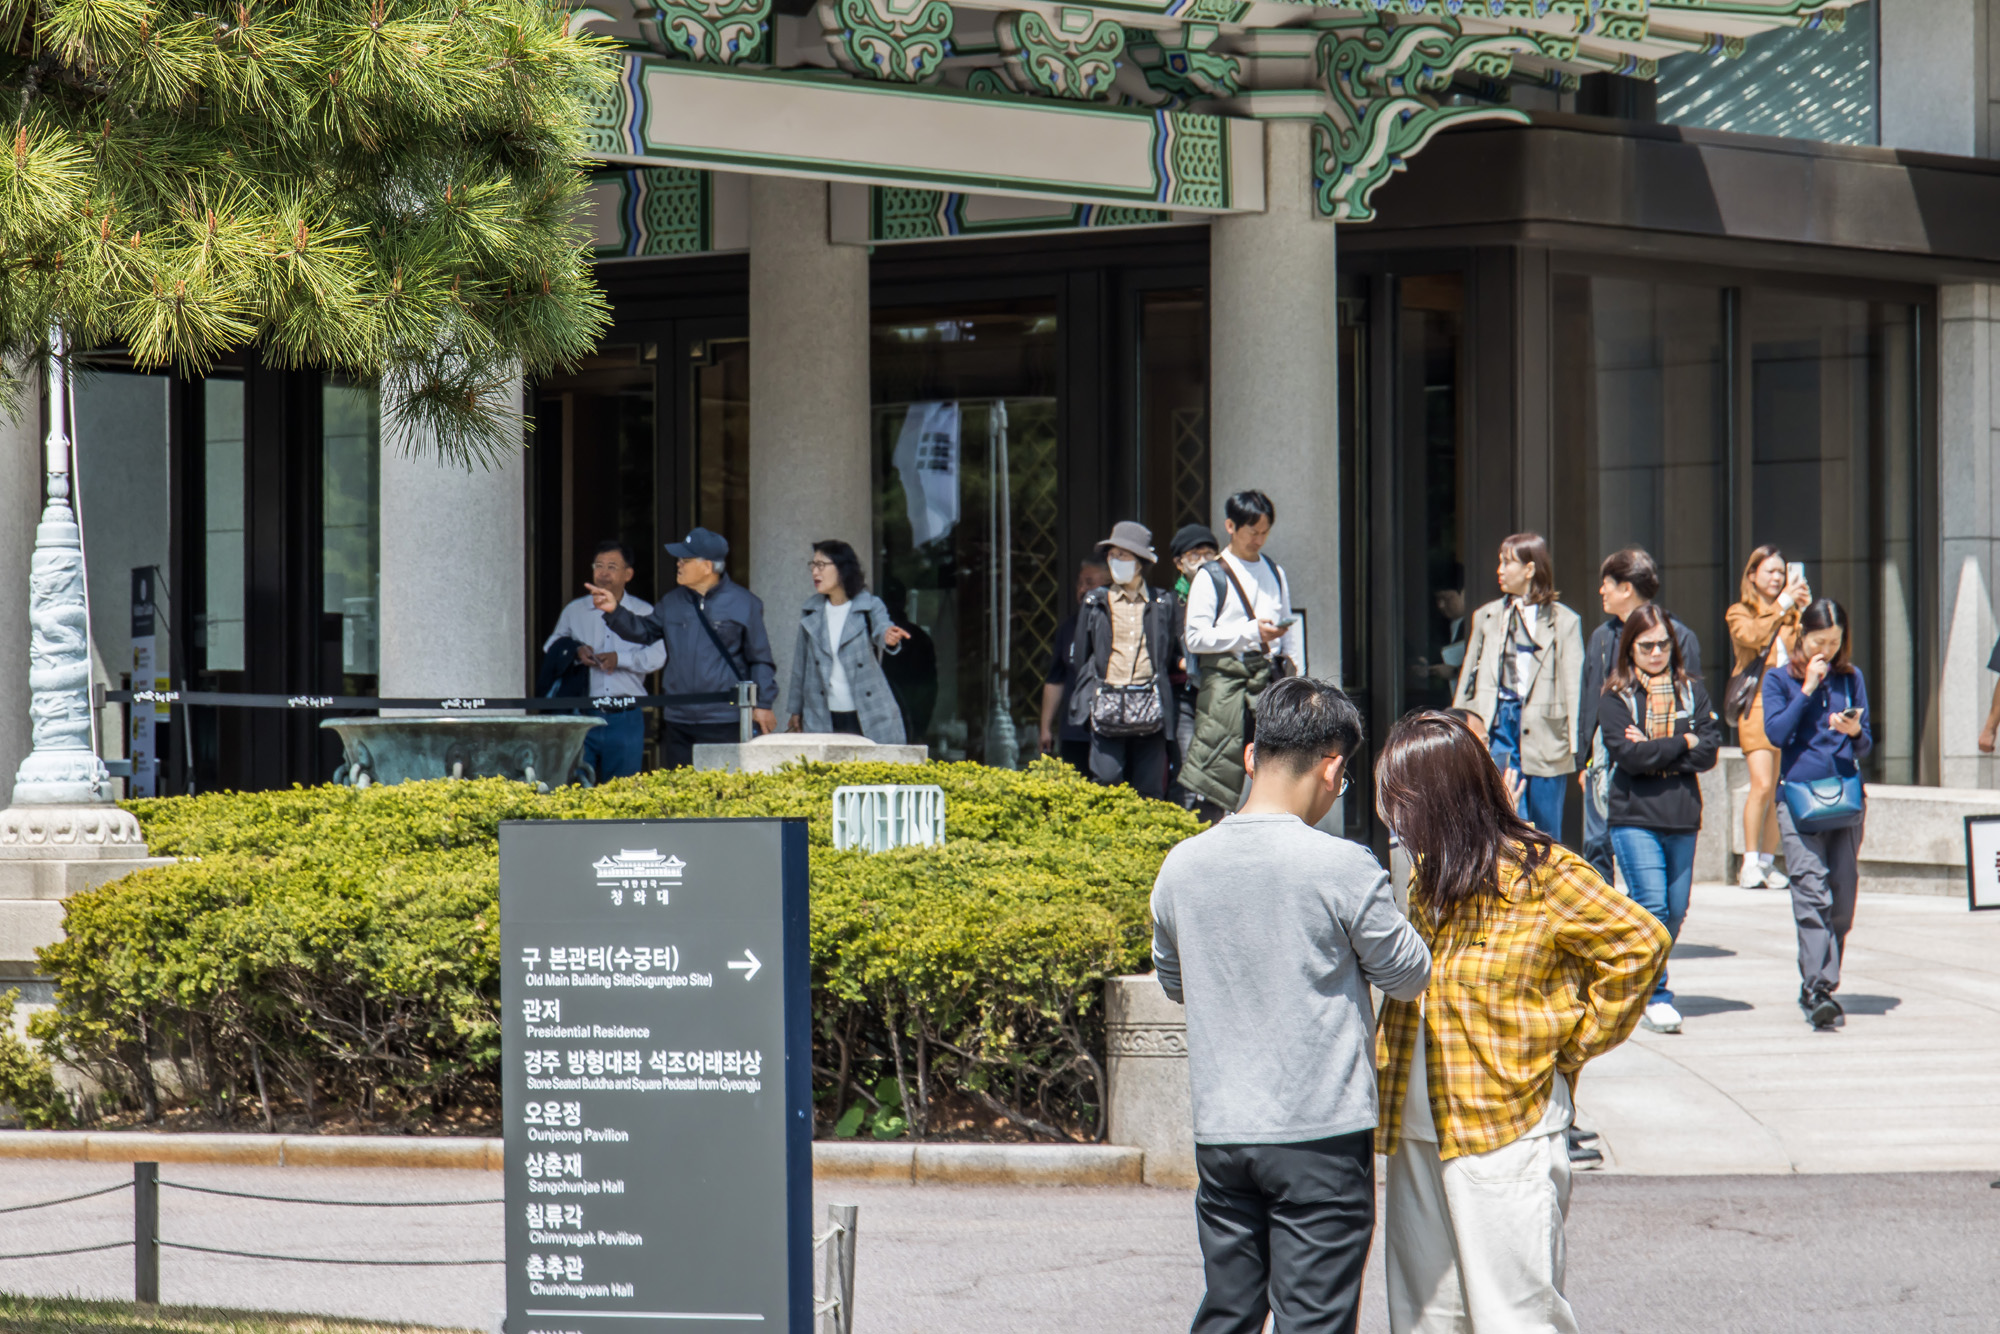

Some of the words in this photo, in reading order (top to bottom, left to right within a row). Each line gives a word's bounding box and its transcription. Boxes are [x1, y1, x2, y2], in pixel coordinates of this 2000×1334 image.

[521, 948, 541, 971] 구
[548, 945, 679, 972] 본관터(수궁터)
[525, 973, 543, 986] Old
[545, 973, 570, 986] Main
[571, 973, 611, 989] Building
[690, 973, 712, 988] Site)
[522, 998, 560, 1023] 관저
[526, 1025, 590, 1038] Presidential
[593, 1024, 650, 1038] Residence
[524, 1050, 561, 1074] 경주
[567, 1049, 642, 1075] 방형대좌
[648, 1050, 762, 1075] 석조여래좌상
[527, 1076, 552, 1089] Stone
[552, 1076, 581, 1089] Seated
[582, 1076, 614, 1090] Buddha
[615, 1077, 631, 1090] and
[632, 1076, 662, 1092] Square
[663, 1076, 698, 1090] Pedestal
[699, 1076, 719, 1090] from
[721, 1076, 762, 1094] Gyeongju
[524, 1101, 581, 1126] 오운정
[528, 1127, 582, 1144] Ounjeong
[584, 1128, 629, 1142] Pavilion
[525, 1152, 582, 1178] 상춘재
[529, 1178, 600, 1195] Sangchunjae
[602, 1180, 624, 1193] Hall
[525, 1203, 583, 1229] 침류각
[529, 1230, 596, 1247] Chimryugak
[597, 1231, 642, 1245] Pavilion
[526, 1254, 584, 1281] 춘추관
[530, 1281, 609, 1299] Chunchugwan
[611, 1283, 633, 1297] Hall
